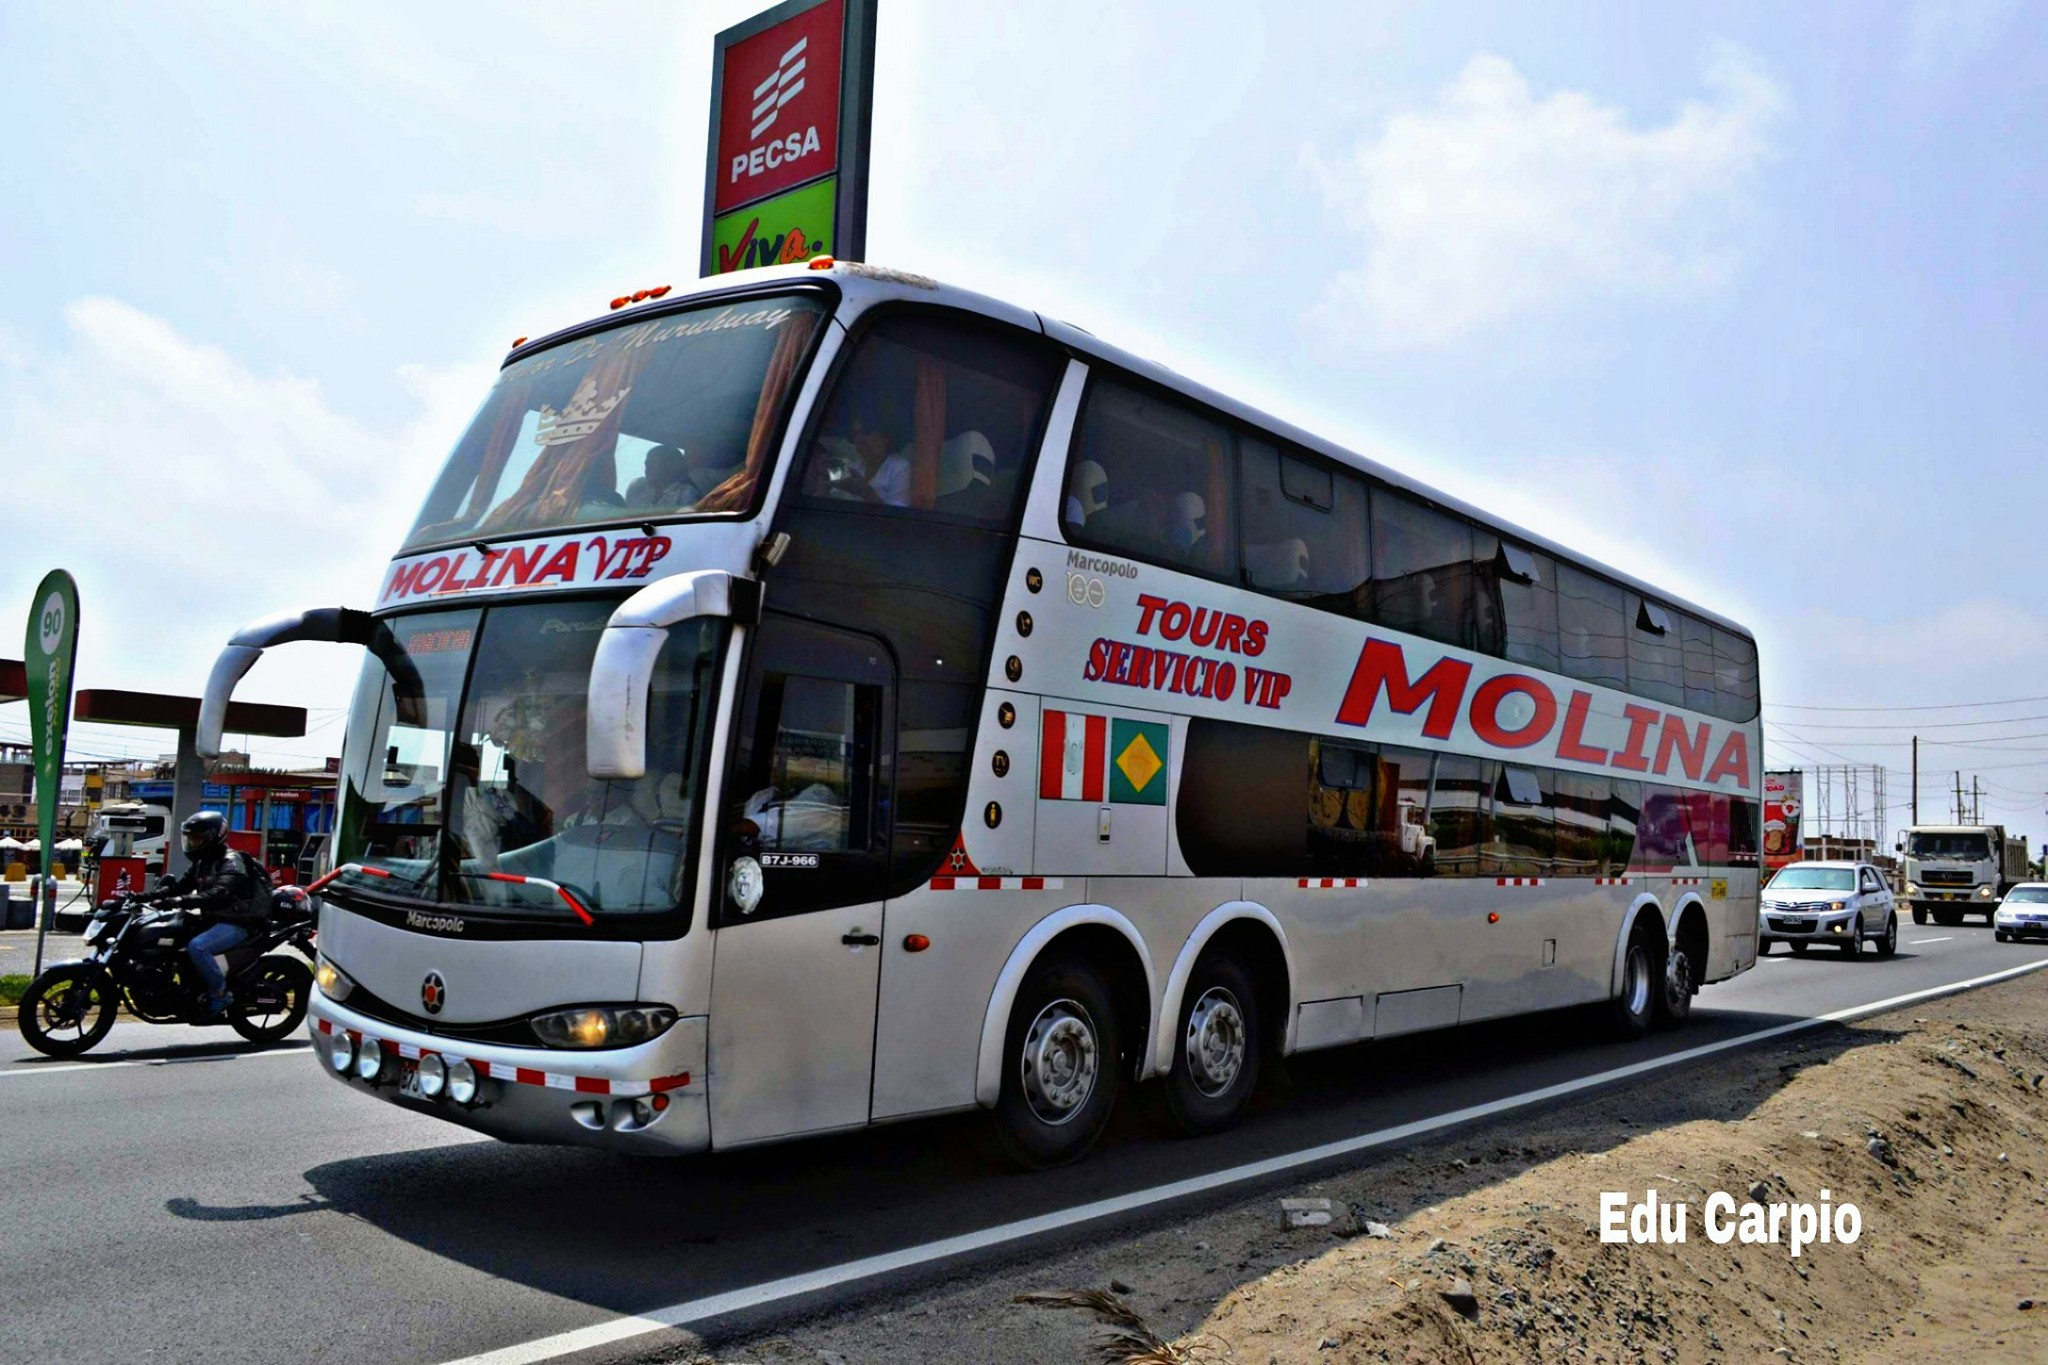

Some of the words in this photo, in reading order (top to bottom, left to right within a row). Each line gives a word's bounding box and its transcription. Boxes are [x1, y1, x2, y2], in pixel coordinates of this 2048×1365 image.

[731, 126, 821, 184] PECSA
[382, 541, 581, 602] MOLINA
[586, 536, 672, 582] VIP
[1028, 575, 1041, 587] WC
[1067, 550, 1138, 579] Marcopolo
[43, 608, 62, 638] 90
[1136, 593, 1269, 657] TOURS
[1083, 637, 1237, 702] SERVICIO
[1244, 665, 1292, 709] VIP
[1335, 636, 1751, 789] MOLINA
[761, 855, 817, 866] B7J-966
[406, 910, 464, 932] Marcopolo
